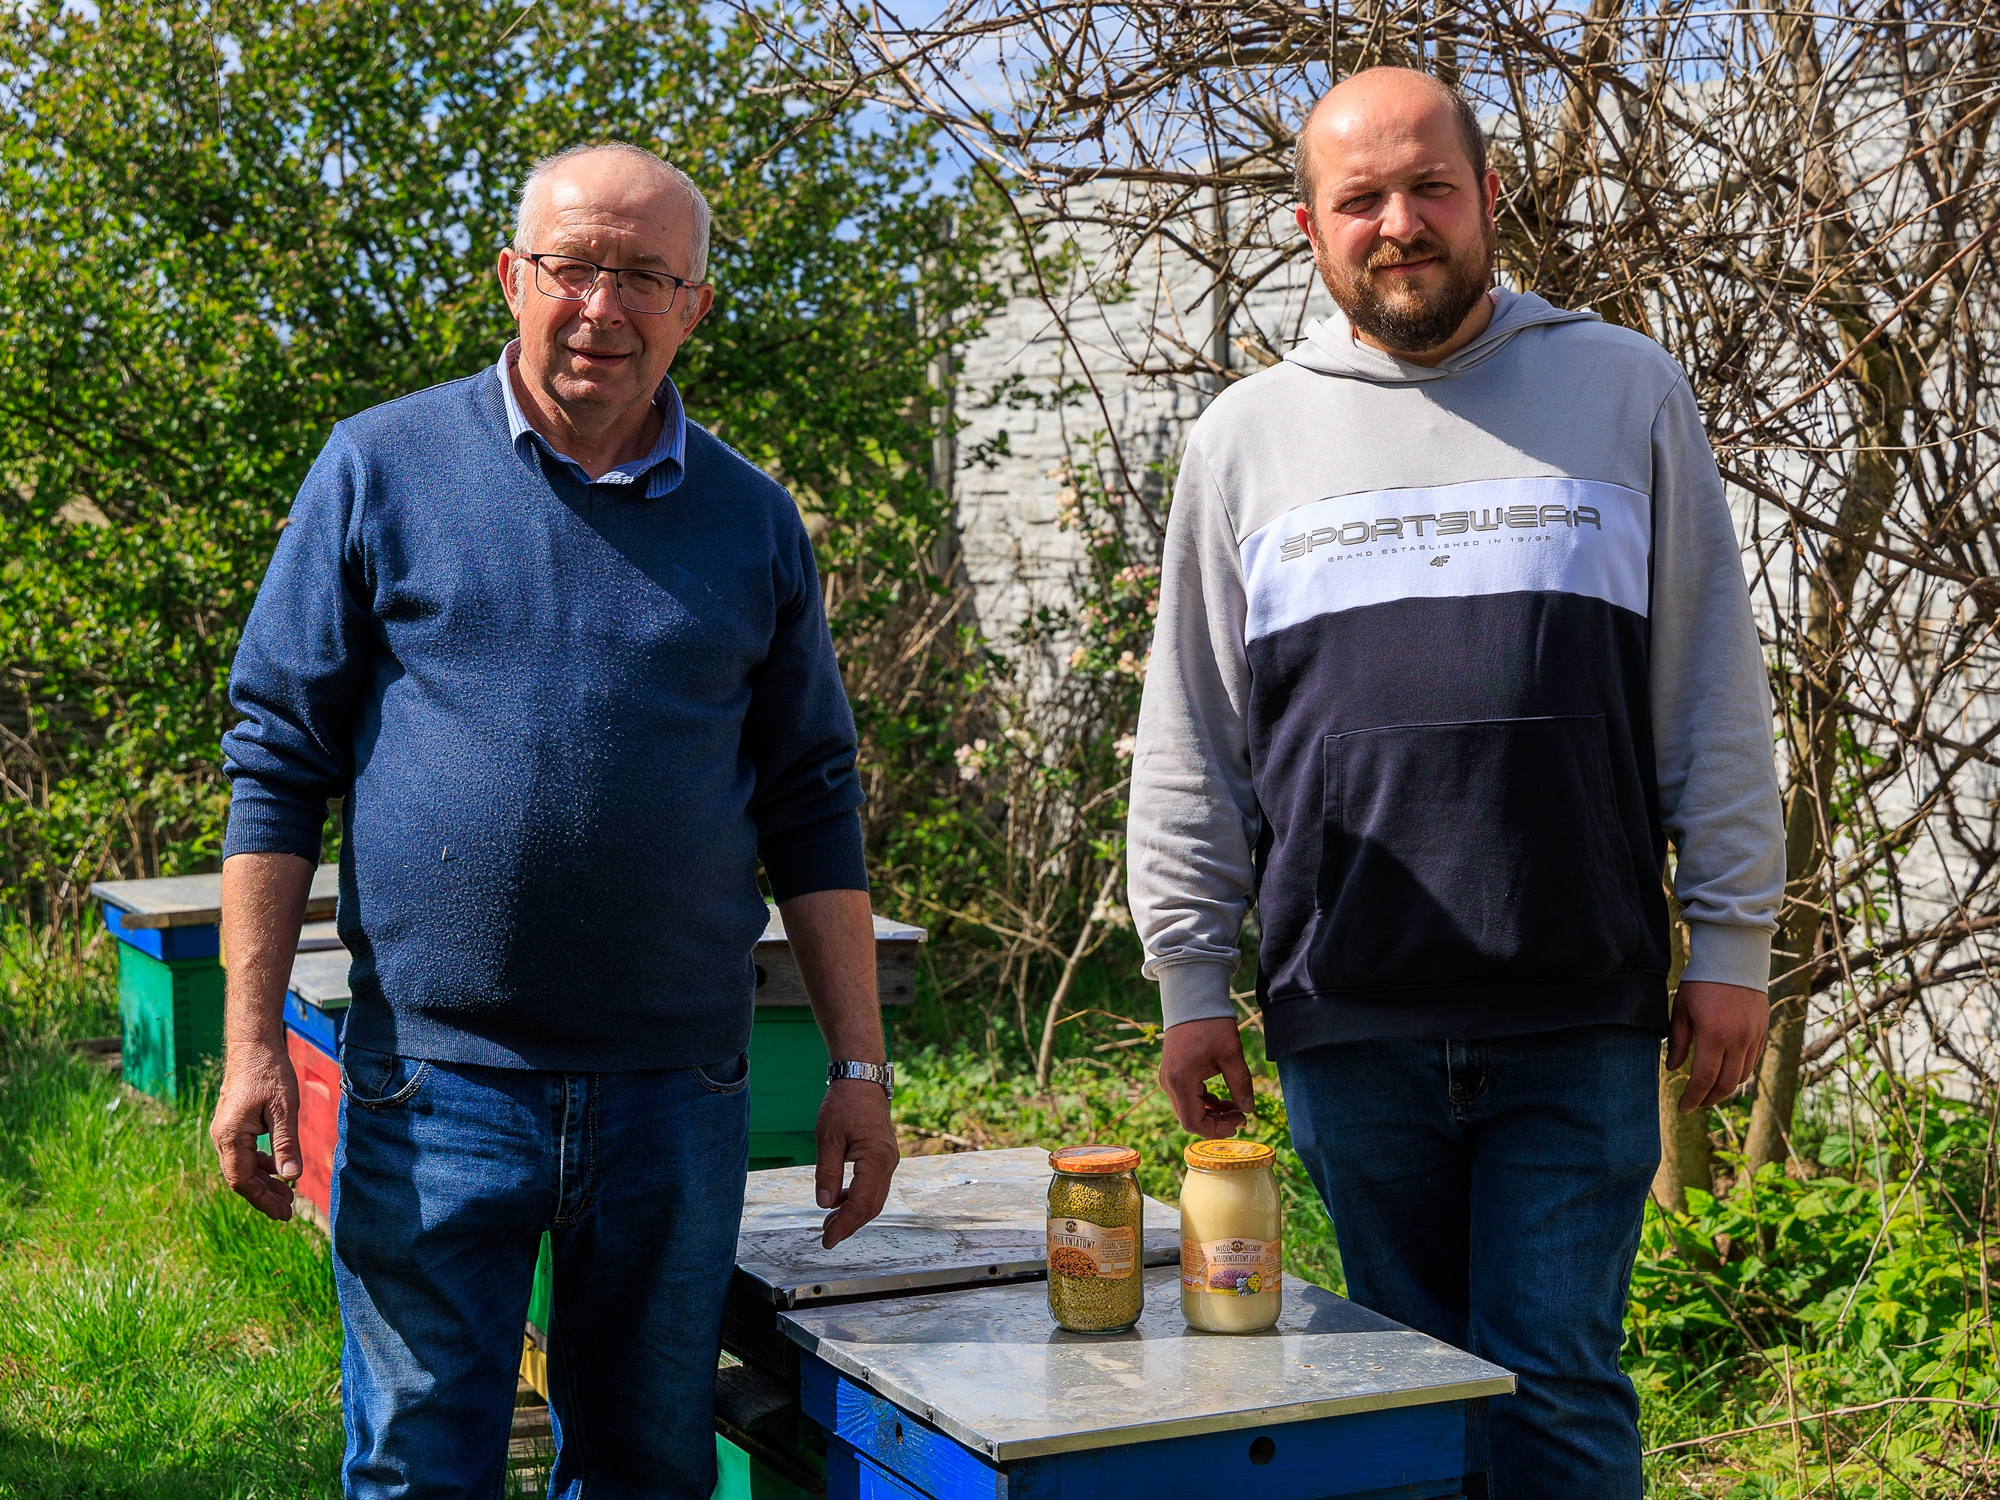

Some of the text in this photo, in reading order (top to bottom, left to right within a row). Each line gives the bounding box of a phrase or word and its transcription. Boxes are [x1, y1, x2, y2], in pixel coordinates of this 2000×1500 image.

[1280, 504, 1602, 563] SPORTSWEAR
[1327, 550, 1374, 563] BRAND
[1381, 539, 1481, 555] ESTABLISHED
[1510, 535, 1553, 543] 19/95
[1429, 555, 1451, 567] 4F
[1215, 1243, 1231, 1253] MIÓD
